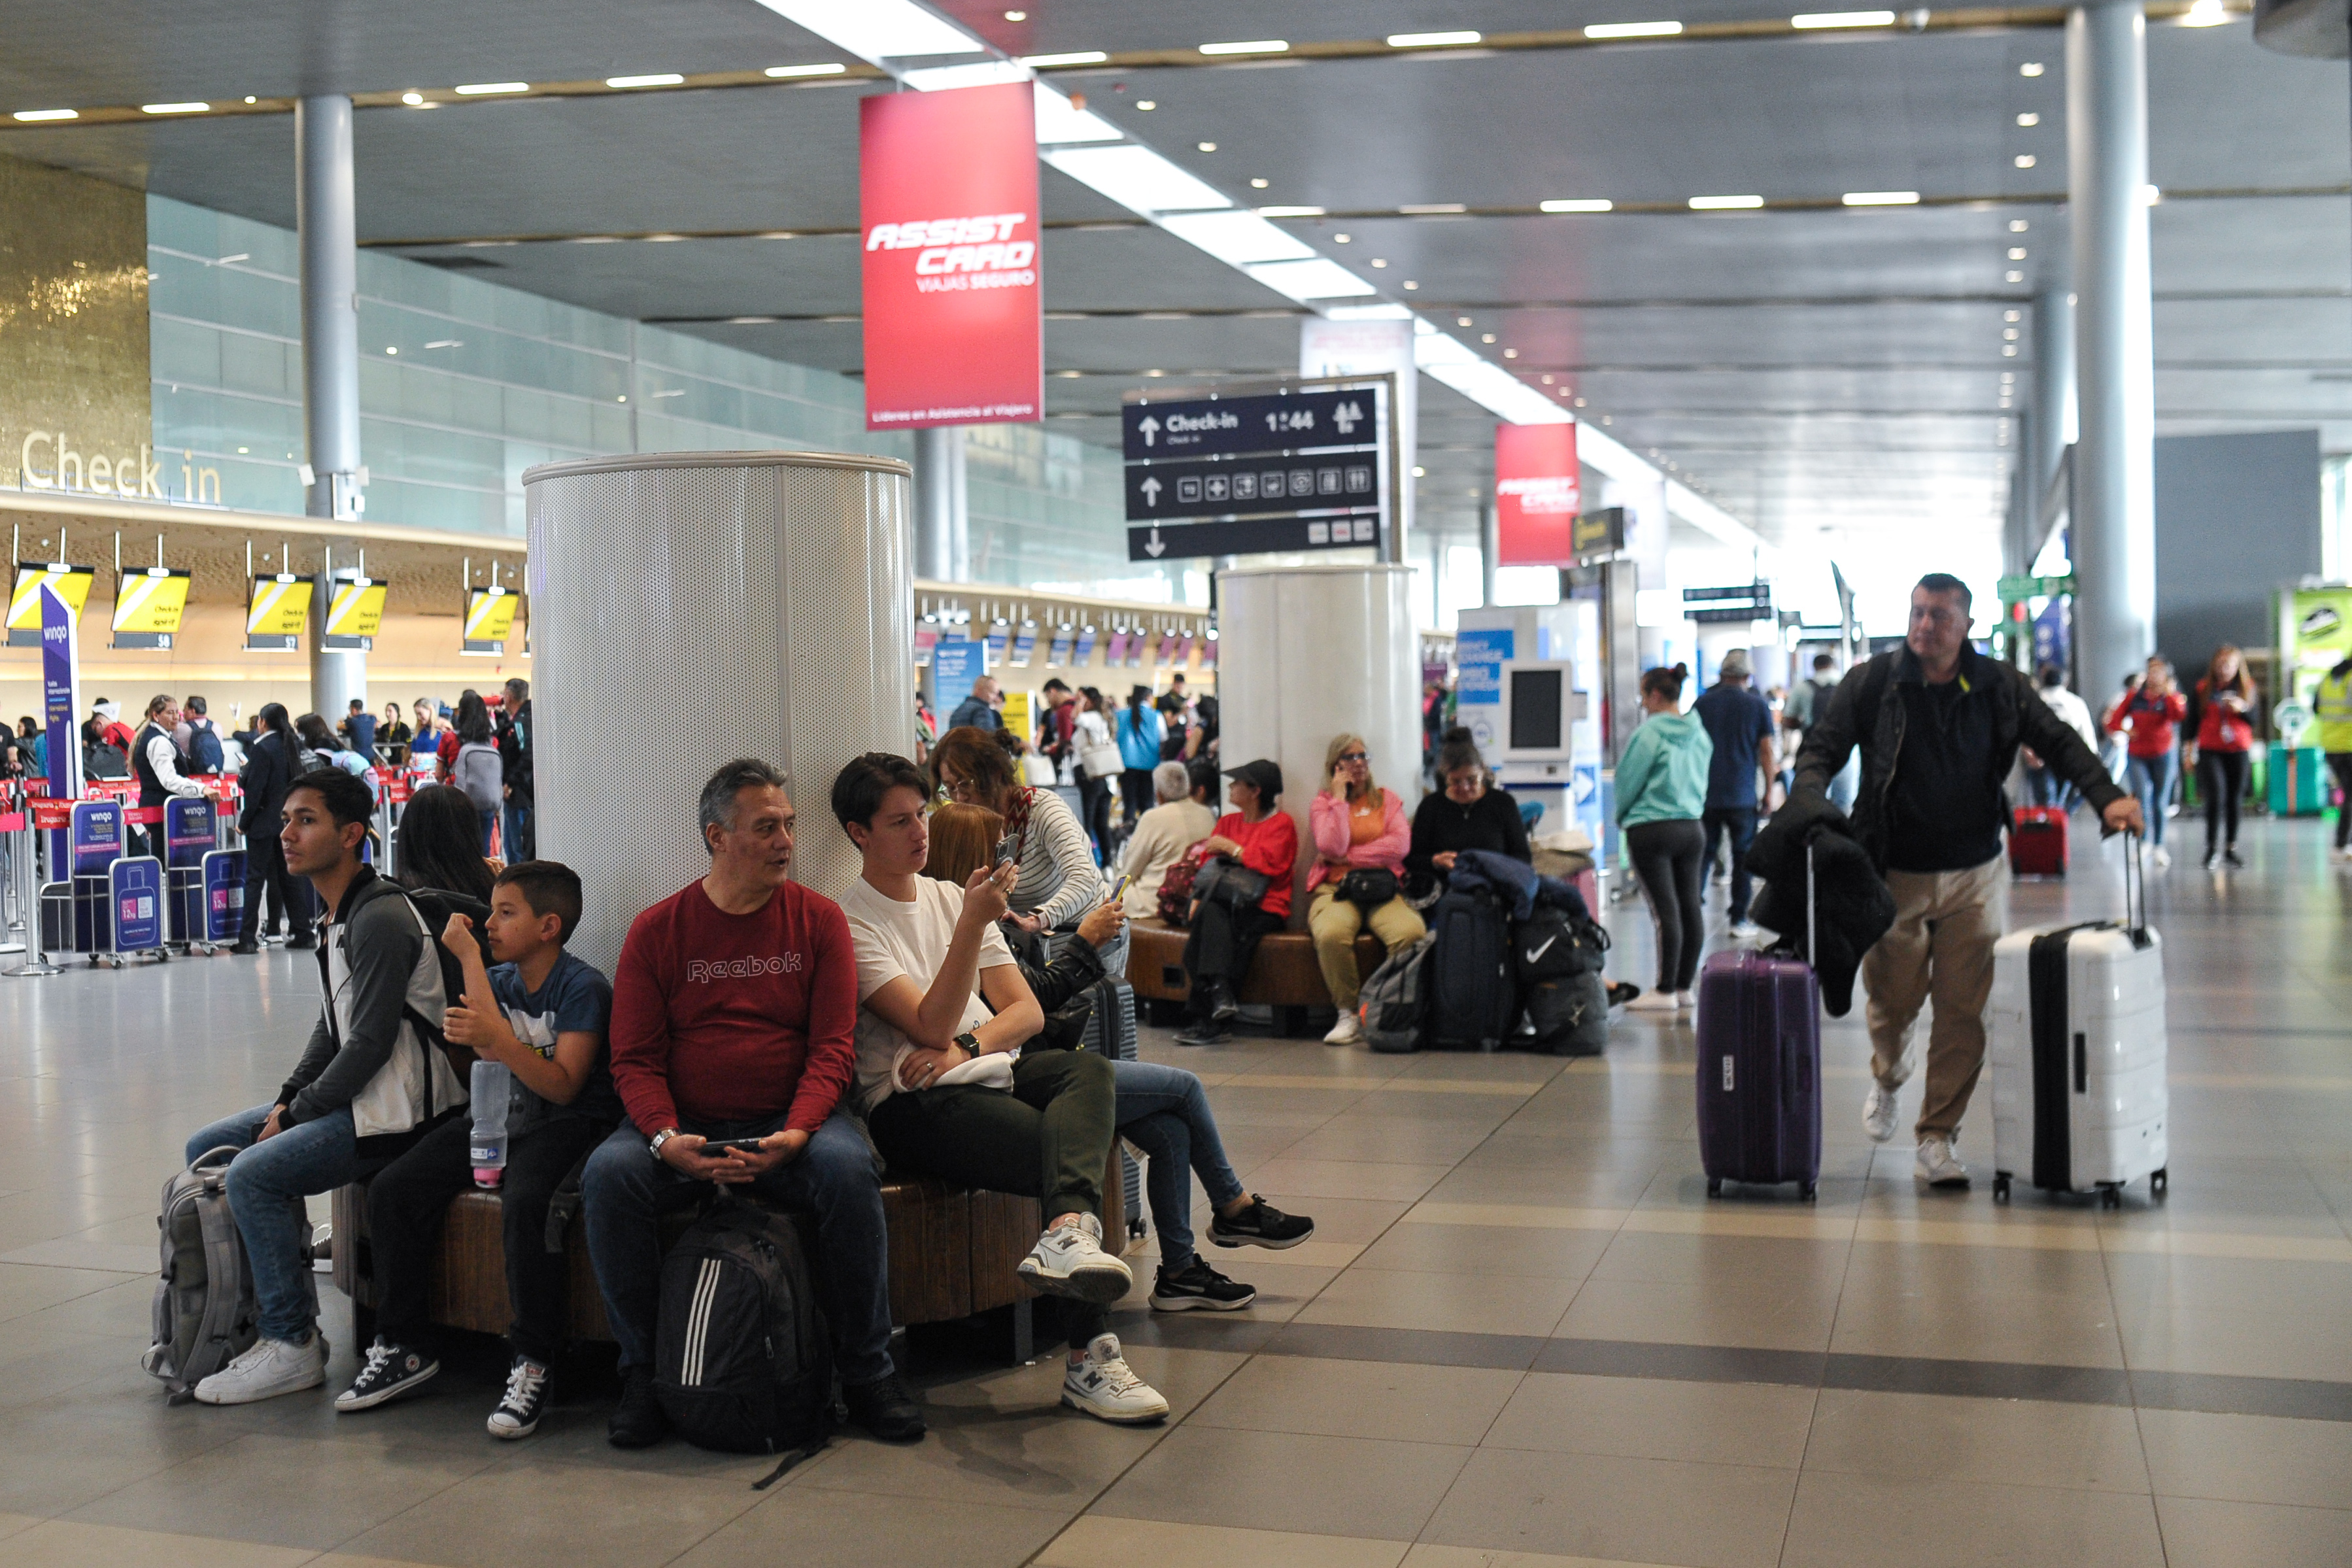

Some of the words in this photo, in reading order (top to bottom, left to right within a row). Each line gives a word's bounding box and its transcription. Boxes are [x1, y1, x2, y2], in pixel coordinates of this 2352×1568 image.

[866, 213, 1027, 252] ASSIST
[915, 241, 1036, 275] CARD
[969, 268, 1036, 290] SEGURO
[1166, 410, 1238, 432] Check-in
[22, 430, 163, 500] Check
[181, 449, 221, 504] in
[44, 625, 67, 644] wingo
[91, 811, 112, 823] wingo
[184, 807, 206, 817] wingo
[687, 951, 802, 983] Reebok
